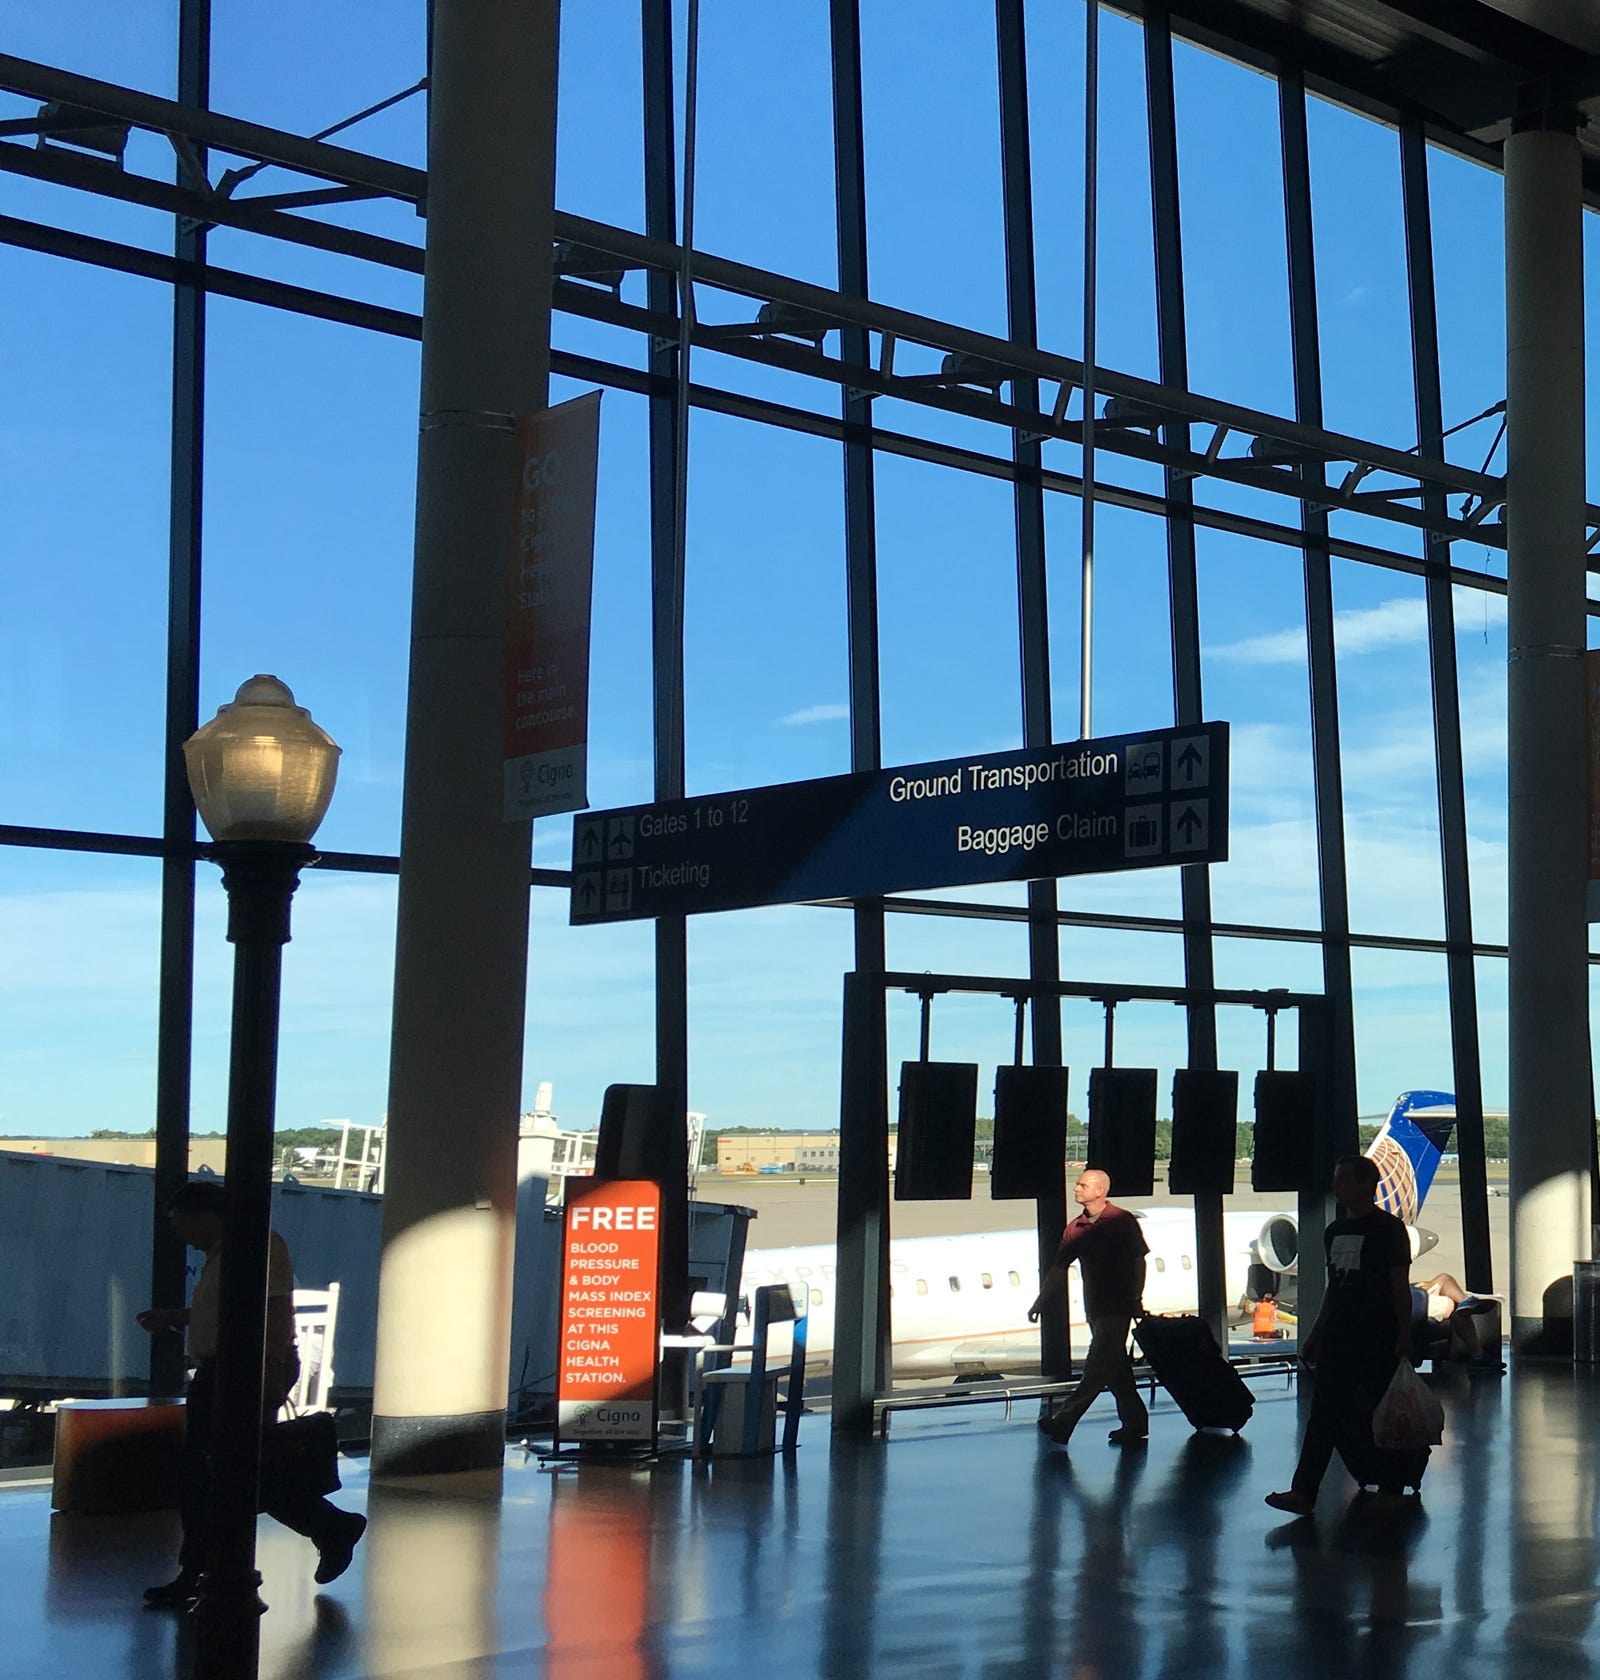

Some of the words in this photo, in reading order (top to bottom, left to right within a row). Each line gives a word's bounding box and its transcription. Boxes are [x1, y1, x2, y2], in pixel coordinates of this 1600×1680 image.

[537, 763, 574, 786] Cigna
[889, 767, 963, 803] Ground
[967, 750, 1118, 792] Transportation
[640, 812, 688, 838] Gates
[693, 807, 701, 830] 1
[707, 804, 723, 828] to
[729, 799, 750, 825] 12
[958, 821, 1049, 855] Baggage
[1056, 811, 1117, 840] Claim
[637, 859, 711, 889] Ticketing
[571, 1206, 656, 1230] FREE
[570, 1243, 619, 1254] BLOOD
[570, 1259, 639, 1269] PRESSURE
[569, 1275, 578, 1285] &
[582, 1275, 620, 1285] BODY
[568, 1291, 606, 1302] MASS
[609, 1291, 651, 1302] INDEX
[568, 1307, 646, 1318] SCREENING
[567, 1324, 586, 1335] AT
[588, 1324, 619, 1335] THIS
[566, 1340, 611, 1351] CIGNA
[566, 1356, 619, 1367] HEALTH
[565, 1372, 627, 1384] STATION.
[597, 1408, 640, 1426] Cigna
